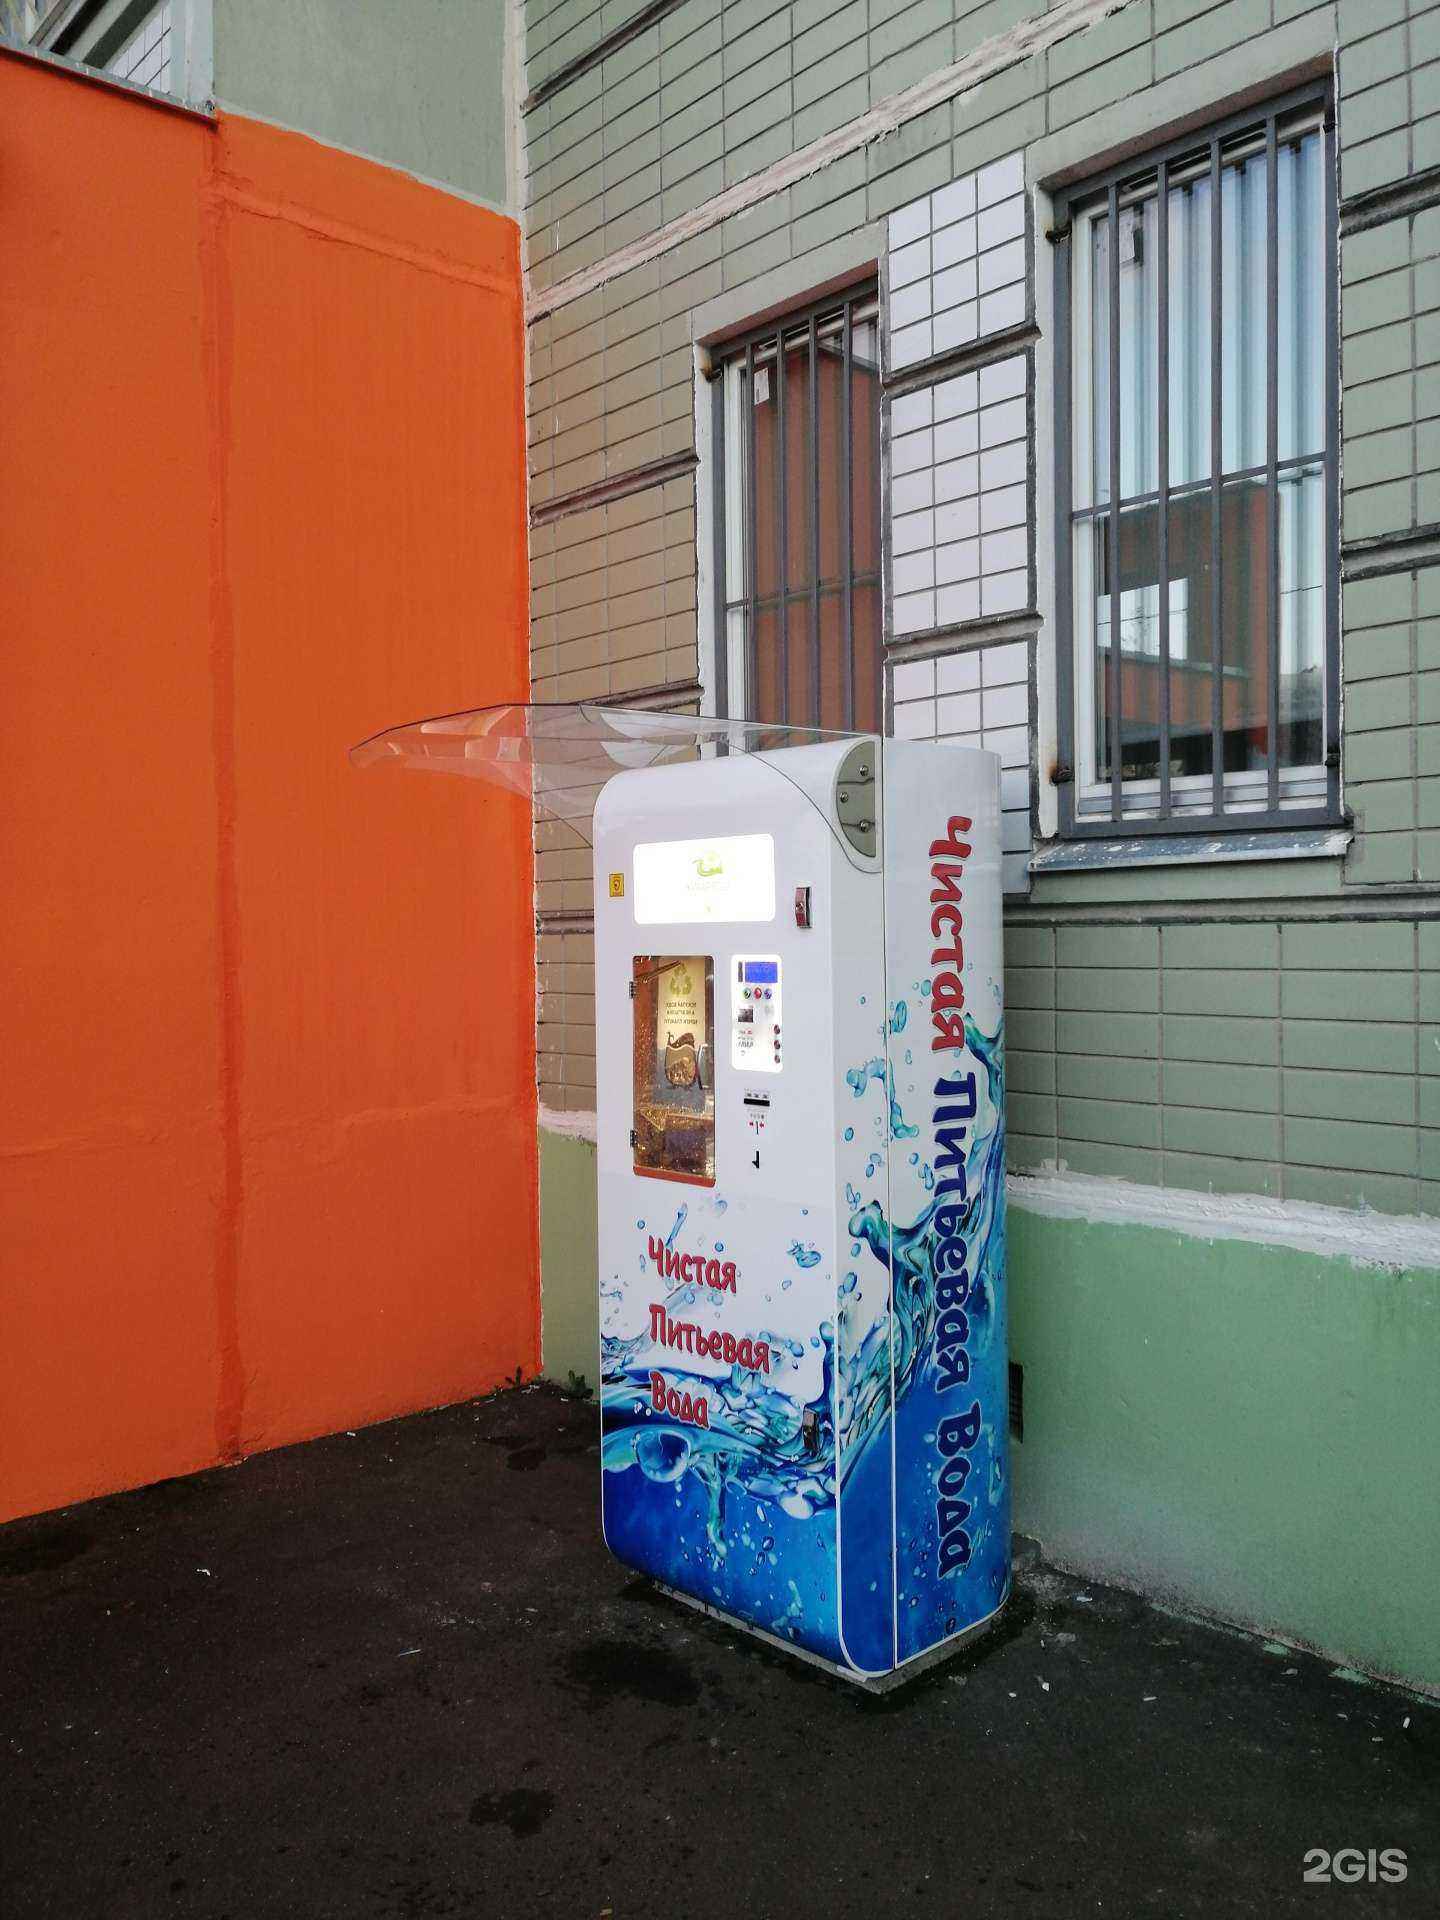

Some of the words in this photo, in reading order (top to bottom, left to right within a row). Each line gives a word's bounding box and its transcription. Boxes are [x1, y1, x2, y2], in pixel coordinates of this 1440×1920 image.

[930, 816, 973, 1050] Чистая
[648, 1235, 737, 1294] Чистая
[932, 1071, 977, 1393] Питьевая
[649, 1303, 770, 1374] Питьевая
[649, 1370, 710, 1429] Вода
[936, 1400, 982, 1579] Вода
